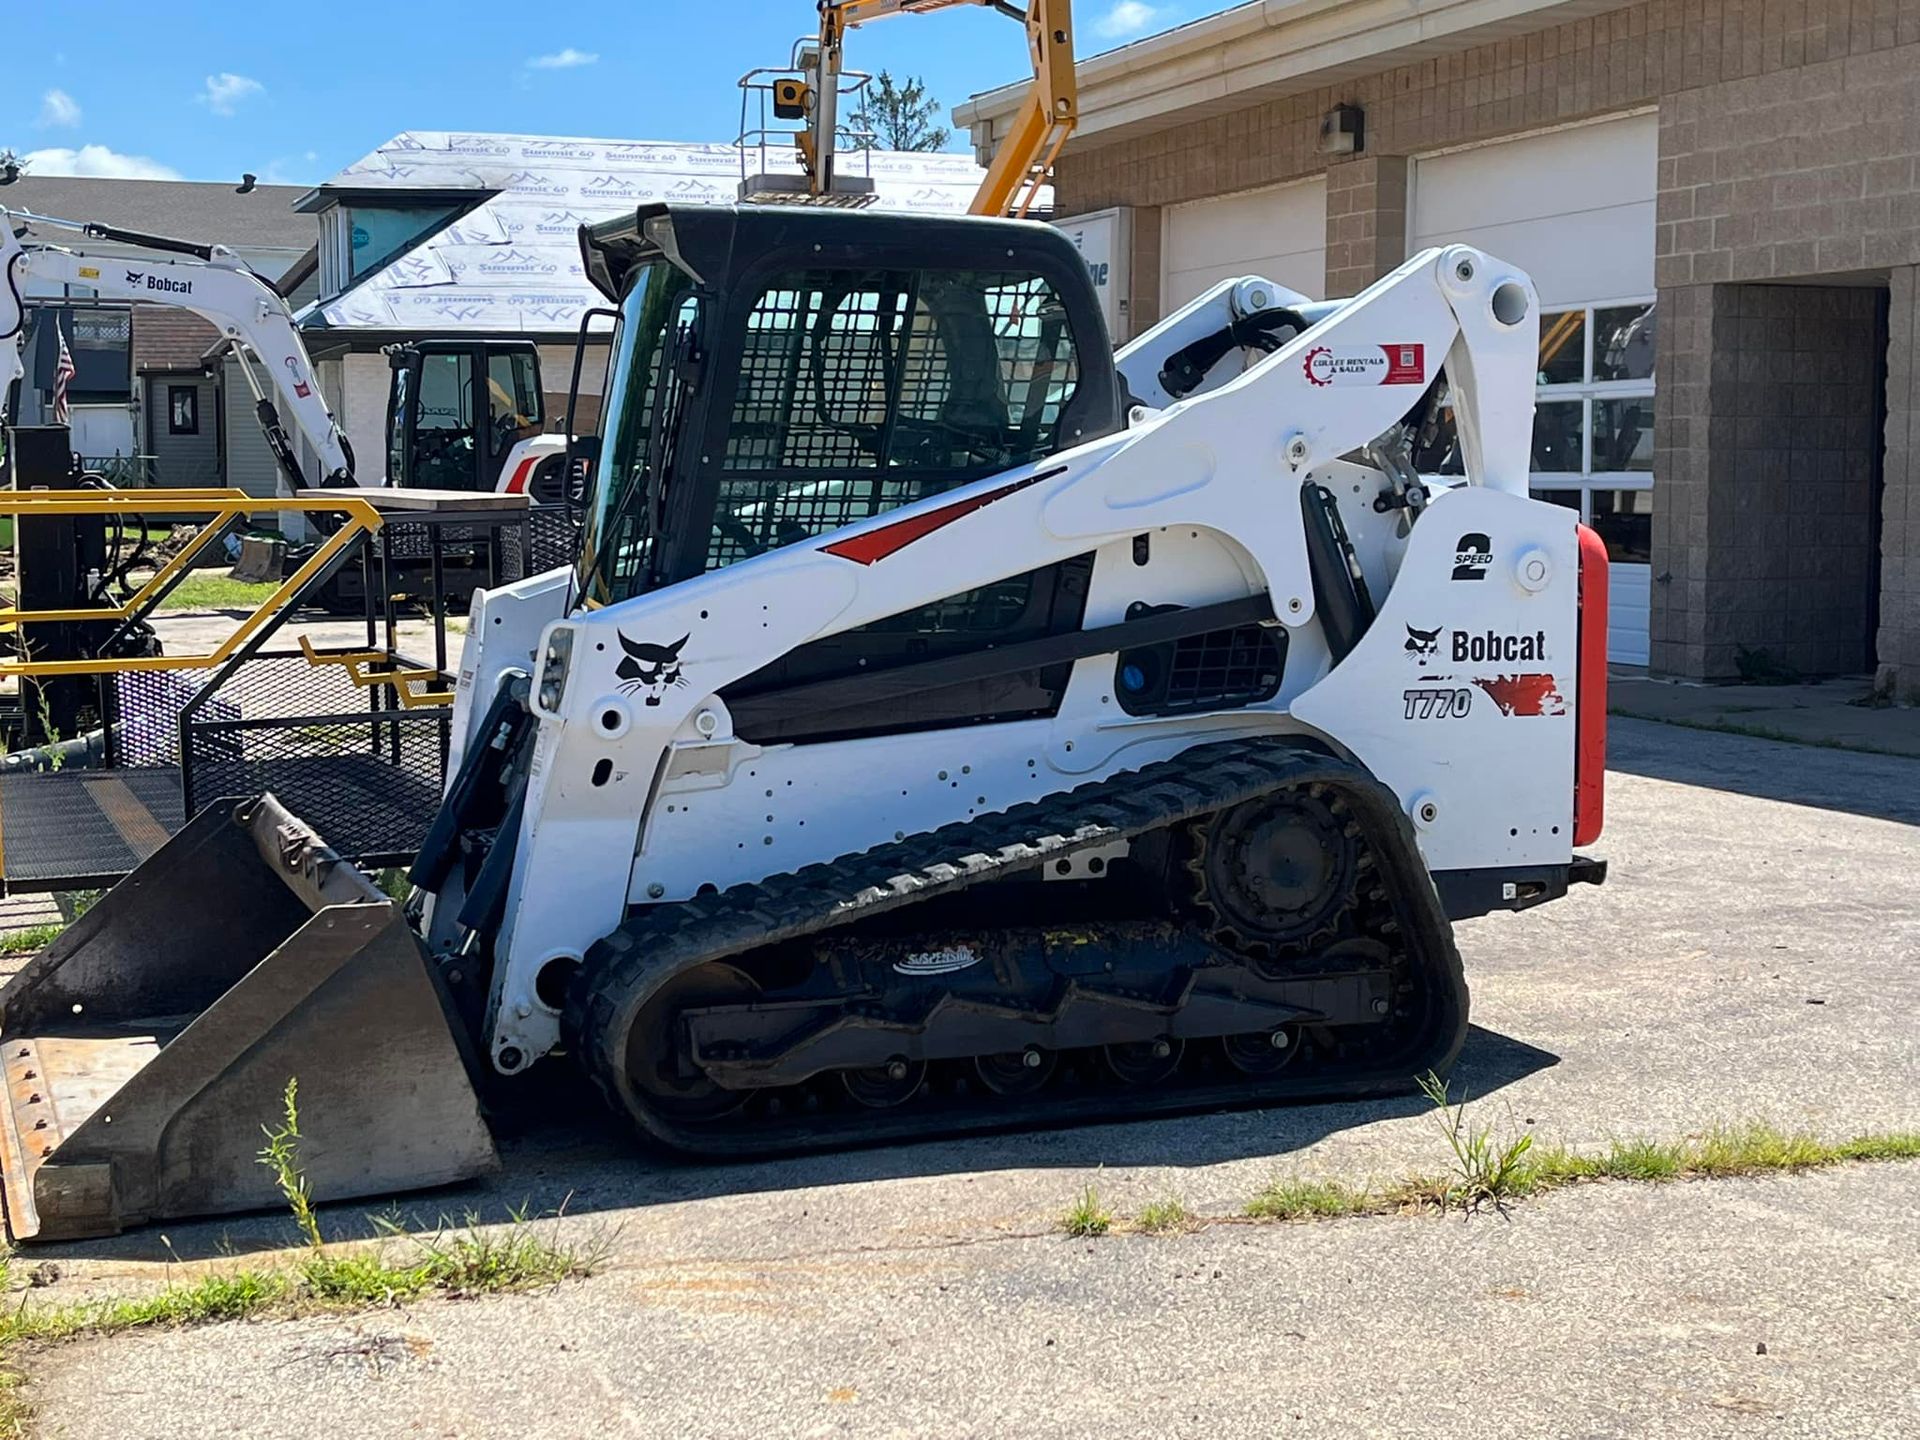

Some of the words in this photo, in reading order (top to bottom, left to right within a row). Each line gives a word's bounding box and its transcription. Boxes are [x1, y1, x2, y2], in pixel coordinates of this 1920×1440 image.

[521, 147, 574, 157] Summit
[605, 151, 656, 160] Summit
[686, 154, 736, 164] Summit
[580, 187, 633, 196] Summit
[664, 191, 715, 200] Summit
[508, 223, 524, 231] 60
[536, 224, 576, 232] Summ
[479, 263, 535, 271] Summit
[540, 264, 557, 272] 60
[147, 275, 192, 295] Bobcat
[1346, 358, 1385, 366] RENTALS
[1330, 366, 1337, 374] &
[1451, 533, 1492, 581] 2
[1454, 554, 1493, 565] SPEED
[1452, 630, 1545, 662] Bobcat
[1403, 688, 1472, 720] T770
